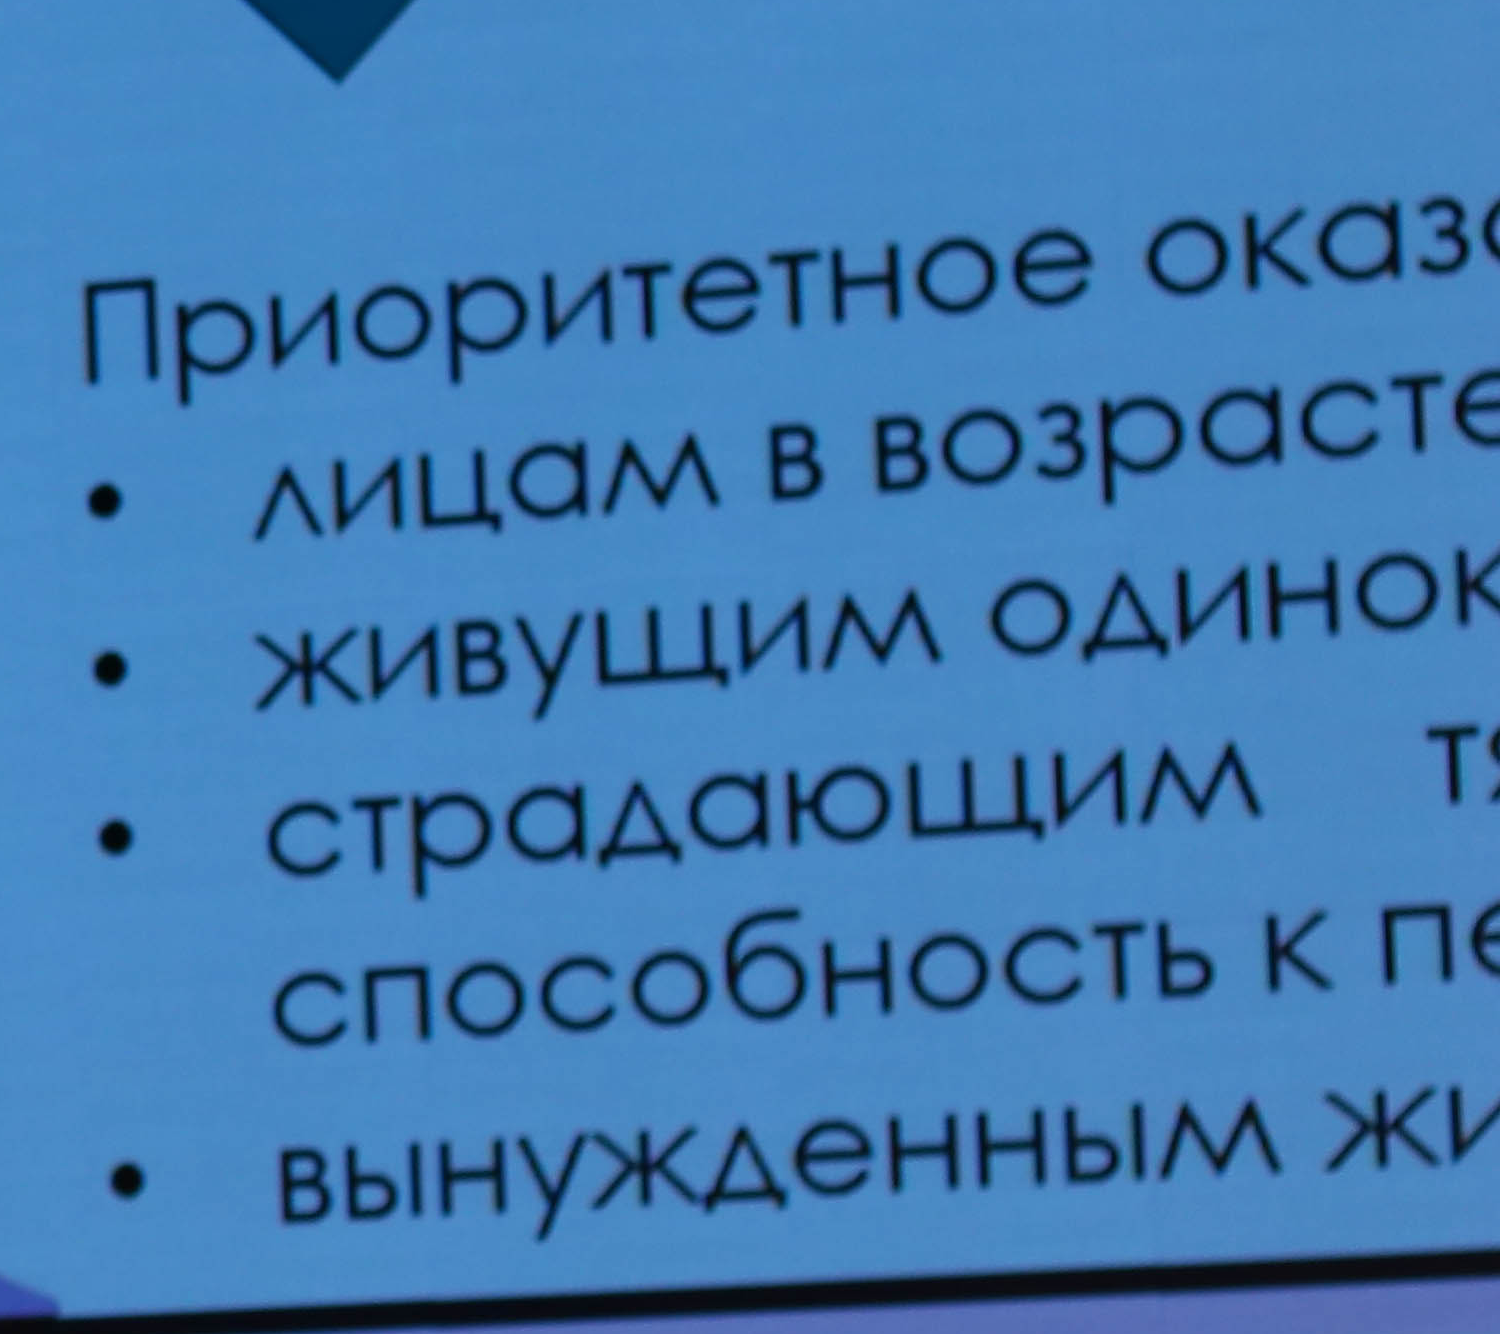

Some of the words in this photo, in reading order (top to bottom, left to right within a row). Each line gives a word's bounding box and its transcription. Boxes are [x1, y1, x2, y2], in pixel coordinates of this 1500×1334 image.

[83, 229, 1093, 406] Приоритетное
[1145, 196, 1500, 296] оказ
[255, 434, 720, 540] лицам
[769, 423, 824, 500] в
[874, 368, 1500, 505] возрасте
[256, 590, 941, 720] живущим
[268, 743, 1261, 898] страдающим
[273, 908, 1214, 1047] способность
[1265, 912, 1330, 991] к
[280, 1101, 1282, 1240] вынужденным
